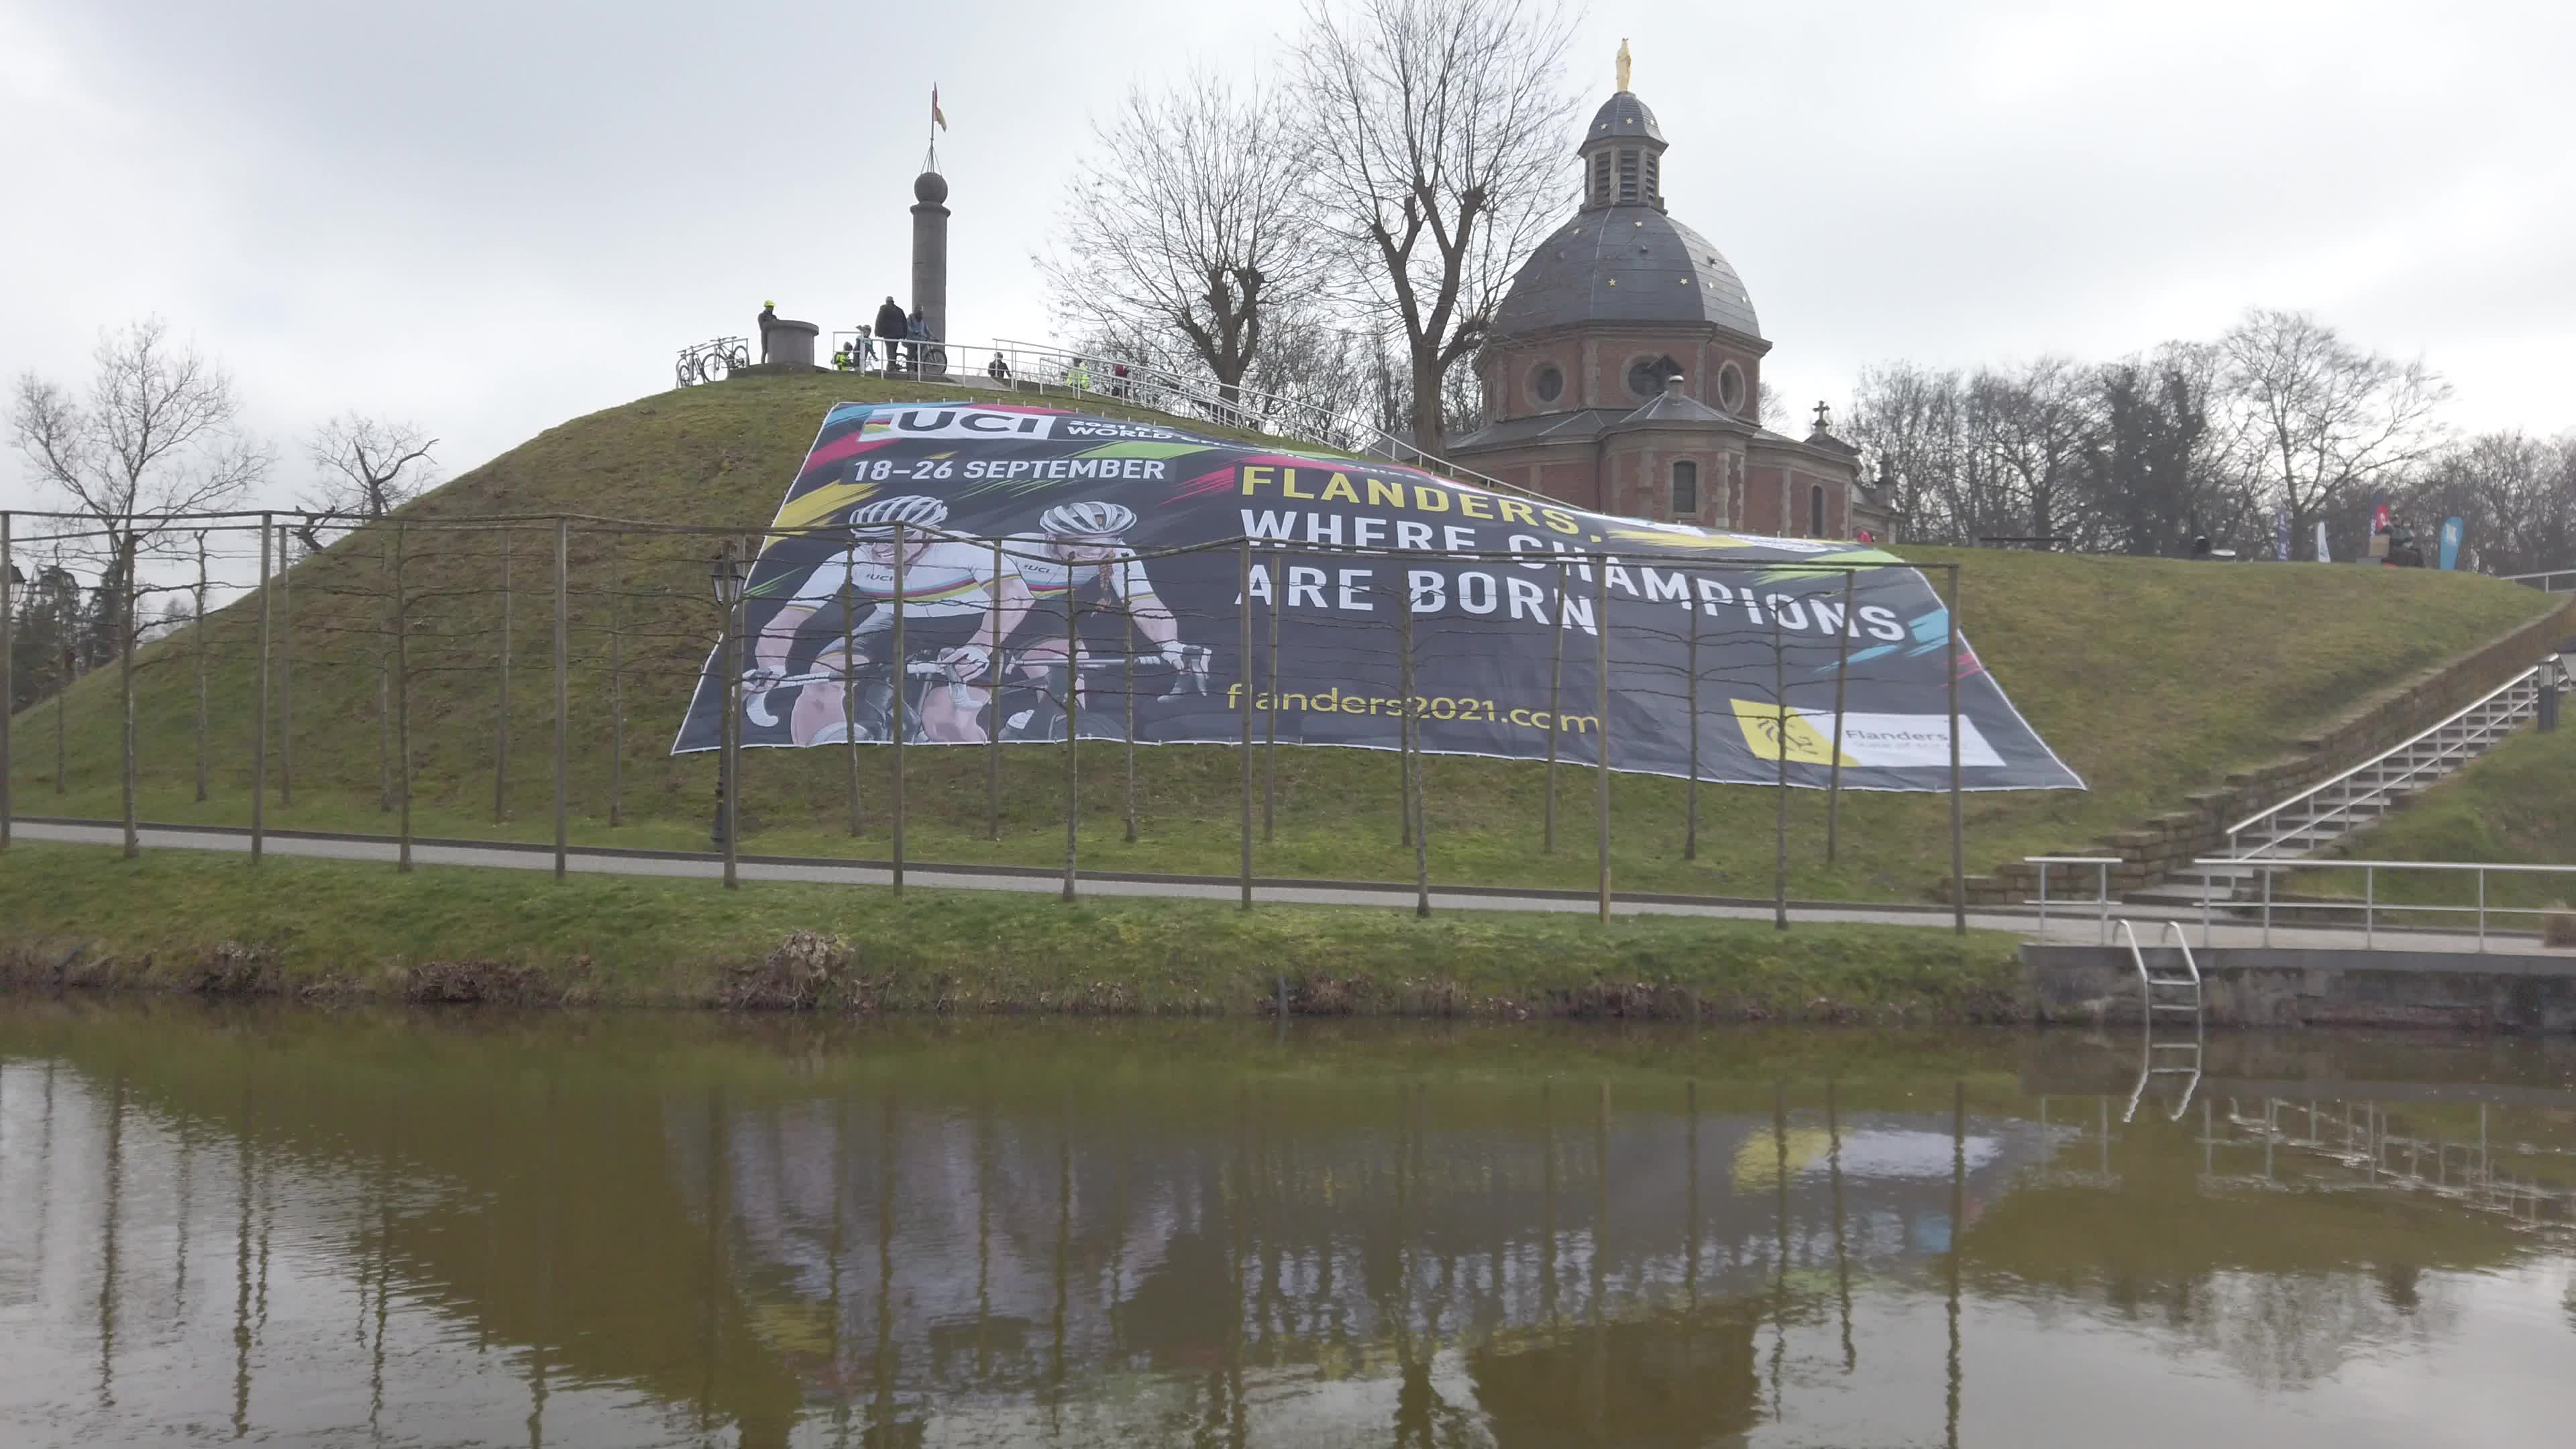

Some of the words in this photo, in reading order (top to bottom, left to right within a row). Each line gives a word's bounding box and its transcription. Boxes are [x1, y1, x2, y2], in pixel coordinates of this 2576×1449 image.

[898, 410, 1040, 434] UCI
[1069, 421, 1126, 430] 2021
[1066, 426, 1173, 439] WORLD
[854, 460, 953, 482] 18-26
[963, 459, 1165, 480] SEPTEMBER
[870, 574, 894, 582] UCI
[1028, 564, 1050, 574] UCI
[1240, 508, 1481, 560] WHERE
[1508, 534, 1906, 641] CHAMPIONS
[1234, 564, 1375, 612] ARE
[1407, 570, 1599, 637] BORN
[1227, 682, 1600, 733] fanders2021.com
[1845, 729, 1949, 741] Flanders
